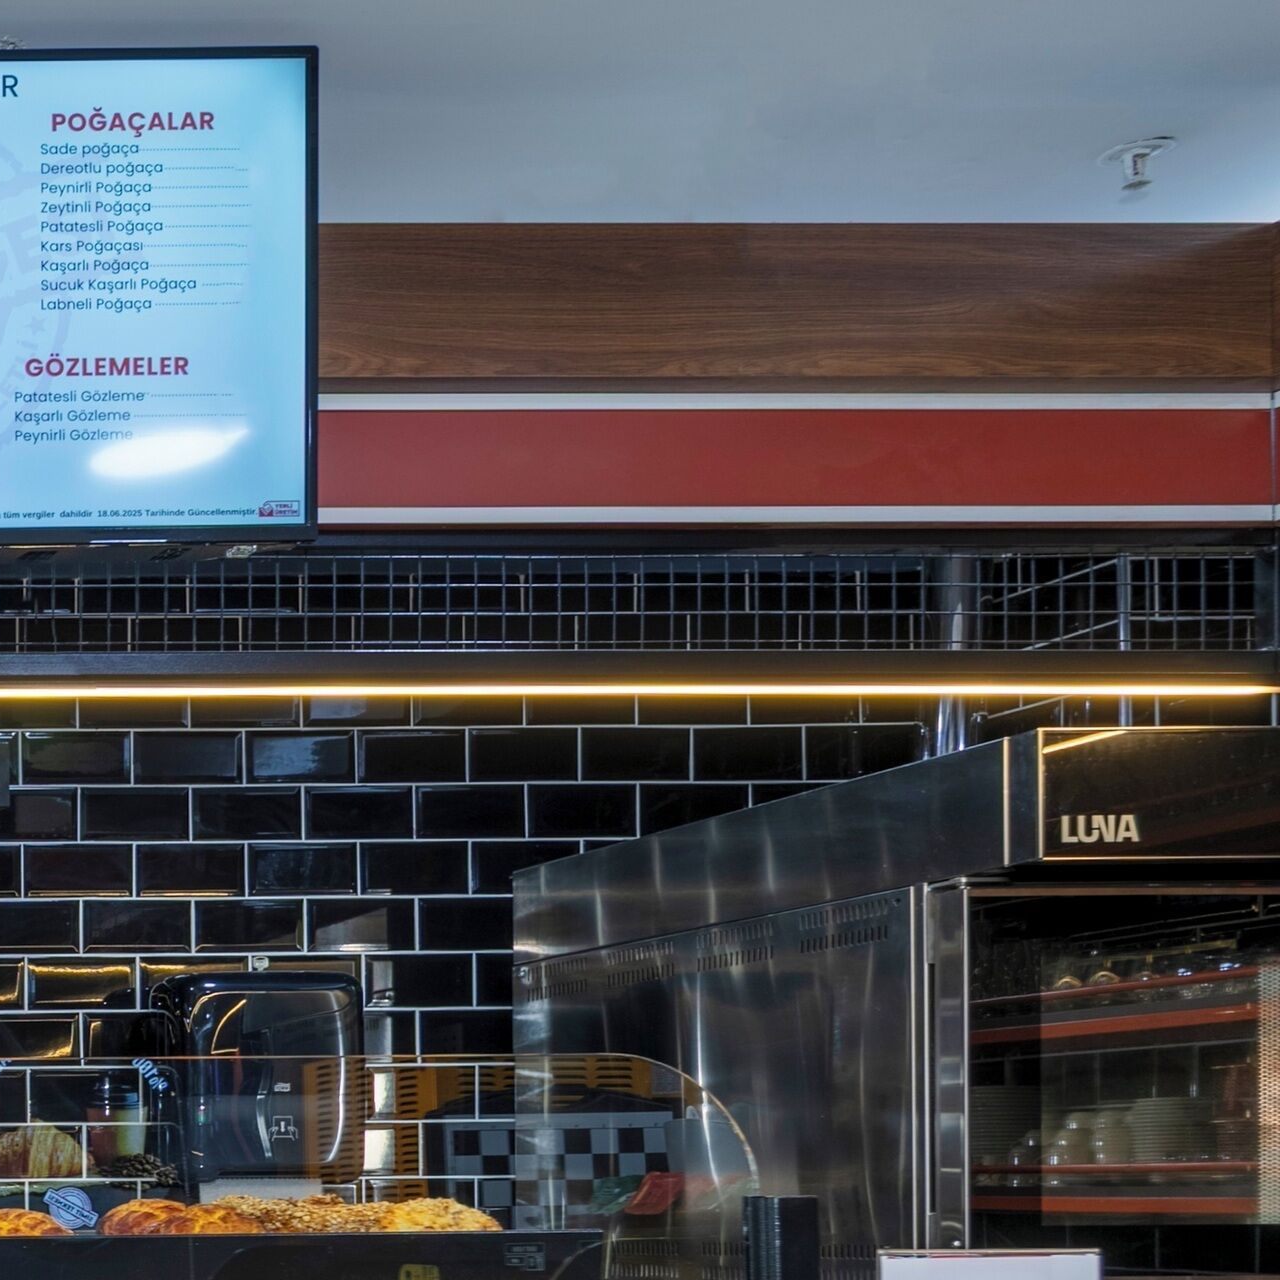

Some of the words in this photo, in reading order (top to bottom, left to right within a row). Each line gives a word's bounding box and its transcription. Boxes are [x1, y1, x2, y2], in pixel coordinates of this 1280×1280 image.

[52, 107, 214, 136] POĞAÇALAR
[40, 143, 78, 155] Sade
[81, 143, 140, 158] poğaça
[40, 162, 102, 174] Dereotlu
[105, 162, 164, 177] poğaça
[40, 181, 92, 197] Peynirli
[94, 181, 153, 196] Poğaça
[40, 200, 92, 216] Zeytinli
[94, 200, 152, 216] Poğaça
[40, 220, 103, 232] Patatesli
[106, 220, 164, 235] Poğaça
[40, 241, 73, 252] Kars
[76, 240, 144, 255] Poğaçası
[40, 259, 90, 275] Kaşarlı
[92, 259, 150, 274] Poğaça
[40, 278, 85, 291] Sucuk
[88, 278, 138, 294] Kaşarlı
[140, 278, 197, 293] Poğaça
[40, 298, 93, 310] Labneli
[95, 298, 153, 313] Poğaça
[25, 354, 190, 377] GÖZLEMELER
[14, 390, 78, 403] Patatesli
[80, 390, 145, 402] Gözleme
[14, 410, 64, 426] Kaşarlı
[67, 409, 131, 422] Gözleme
[14, 429, 66, 445] Peynirli
[68, 428, 133, 442] Gözleme
[1060, 814, 1140, 844] LUNA
